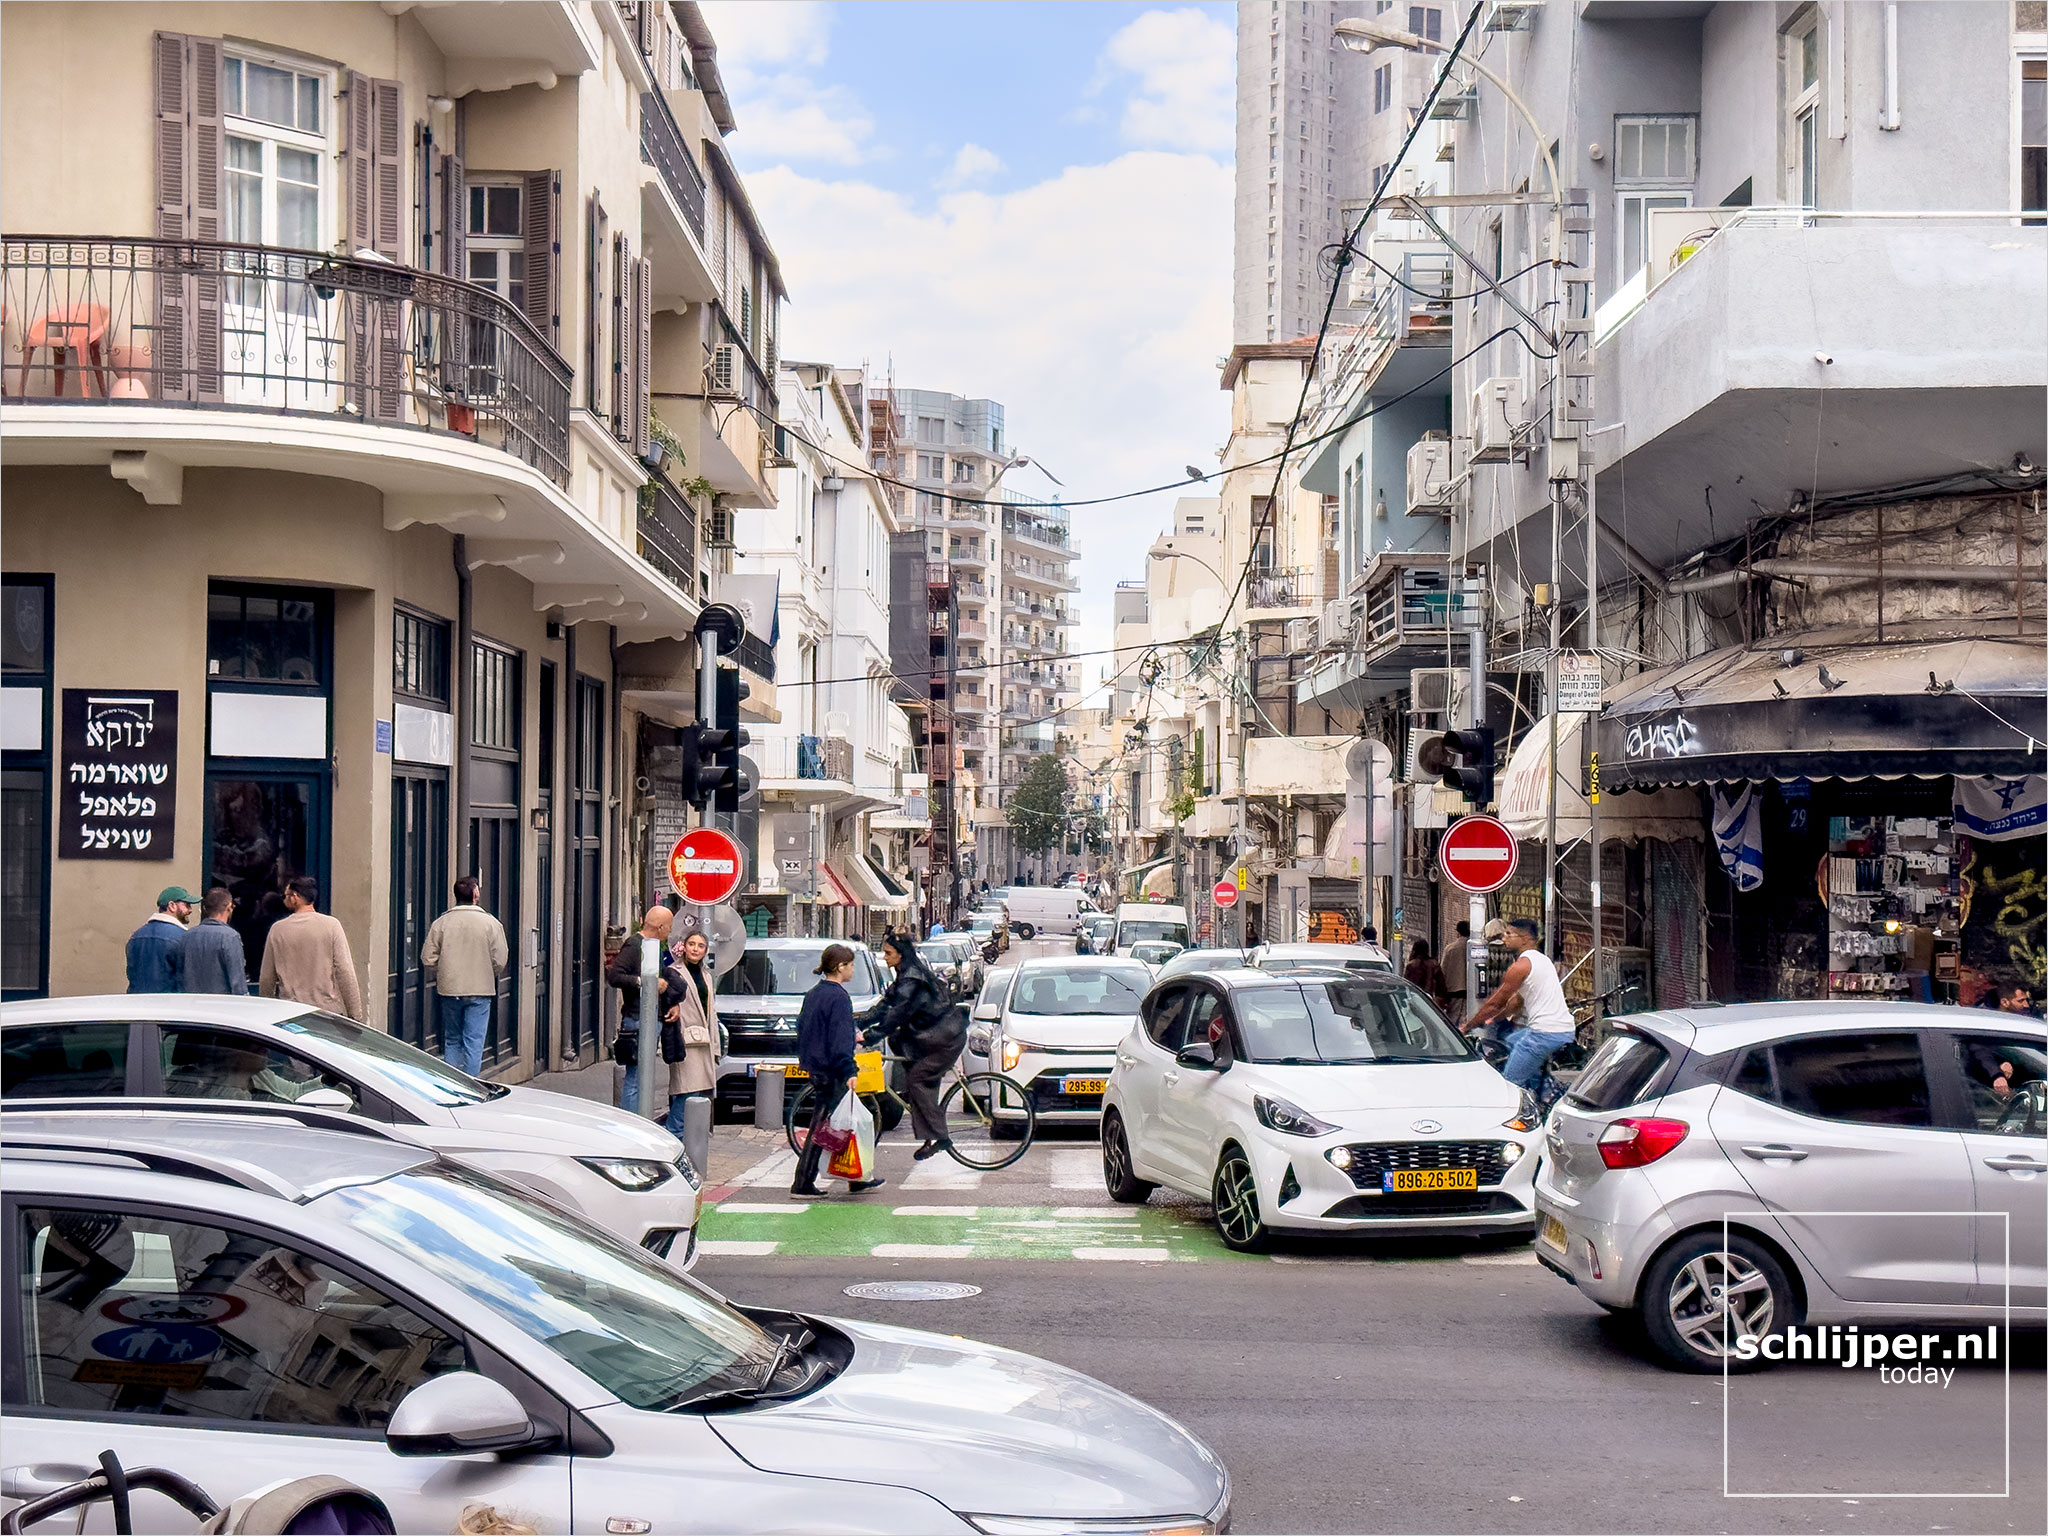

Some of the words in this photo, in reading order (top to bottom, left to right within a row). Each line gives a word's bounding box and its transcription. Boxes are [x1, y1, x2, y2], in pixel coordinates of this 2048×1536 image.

[1560, 691, 1577, 699] Danger
[86, 721, 154, 753] ינוקא
[69, 762, 169, 785] שוארמה
[1591, 754, 1600, 795] 463
[80, 790, 157, 817] פלאפל
[1790, 809, 1807, 828] 29
[2013, 811, 2038, 825] ביחד
[81, 823, 152, 850] שניצל
